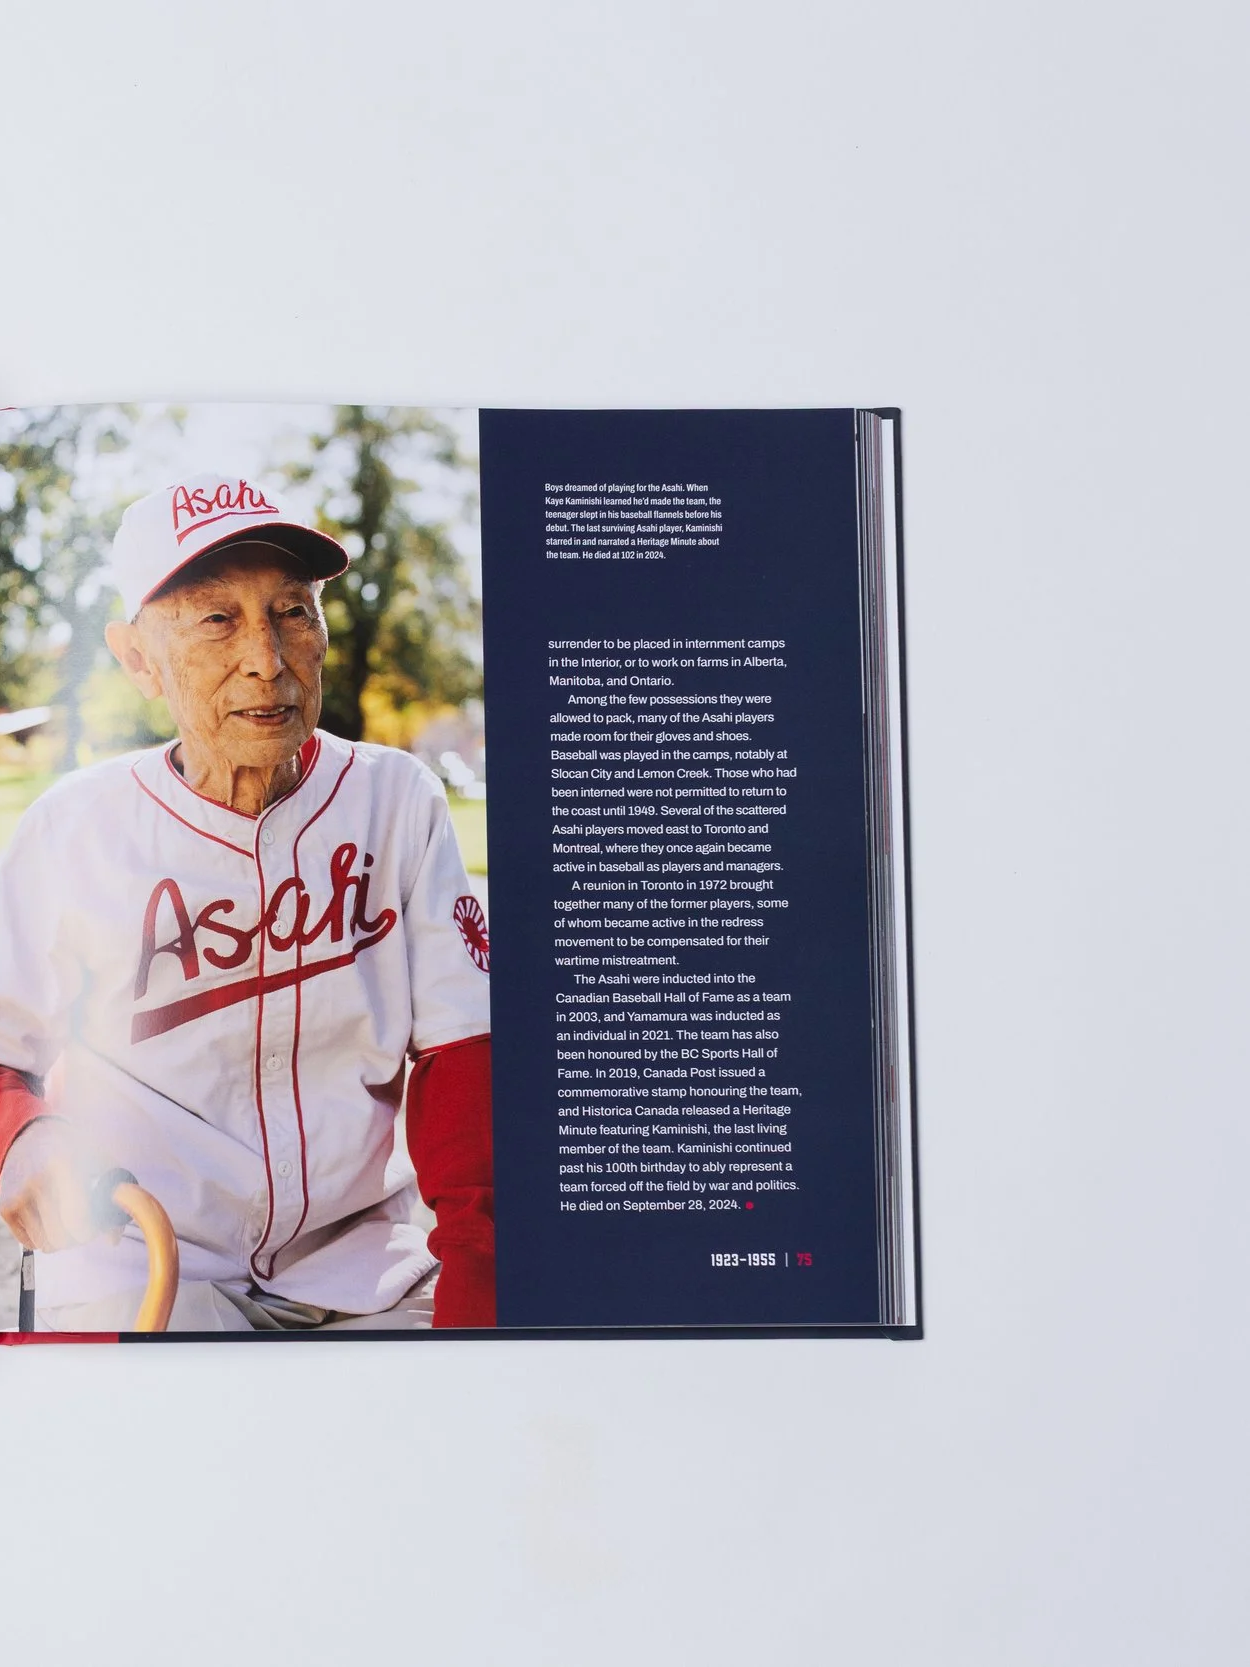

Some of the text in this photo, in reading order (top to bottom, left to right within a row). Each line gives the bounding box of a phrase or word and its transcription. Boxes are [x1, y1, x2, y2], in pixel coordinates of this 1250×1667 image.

[545, 483, 708, 494] Boys dreamed of playing for the Asahi. When
[172, 479, 279, 531] Asahi
[545, 510, 722, 520] teenager slept in his baseball flannels before his
[546, 523, 723, 534] debut. The last surviving Asahi player, Kaminishi
[546, 550, 558, 559] the
[559, 551, 581, 559] team.
[582, 551, 593, 559] He
[594, 550, 611, 559] died
[621, 550, 635, 559] 102
[636, 550, 644, 559] in
[644, 550, 666, 559] 2024.
[550, 676, 674, 687] Manitoba, and Ontario.
[134, 843, 397, 1001] Asahi
[554, 955, 679, 966] wartime mistreatment.
[558, 1066, 766, 1080] Fame. In 2019, Canada Post issued a
[558, 1085, 802, 1098] commemorative stamp honouring the team,
[560, 1199, 741, 1212] He died on September 28, 2024.
[797, 1252, 813, 1266] 75
